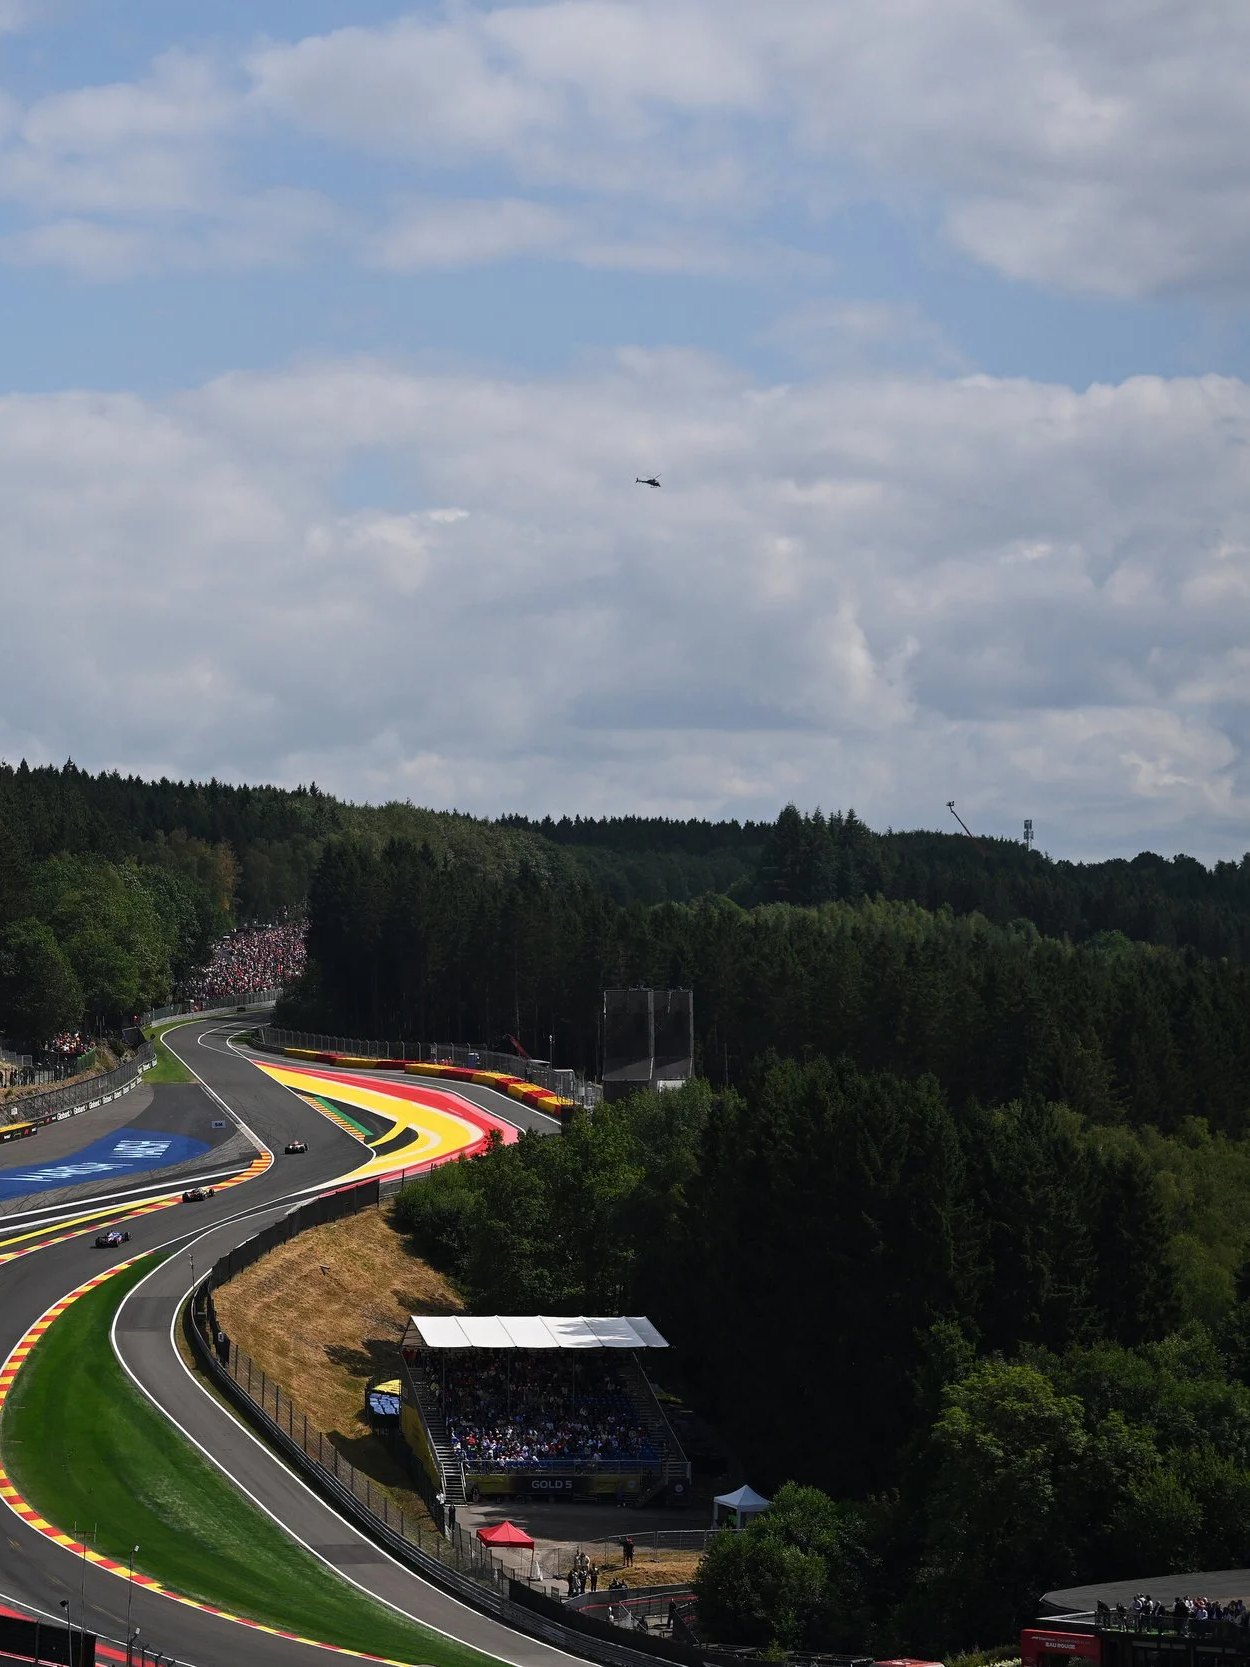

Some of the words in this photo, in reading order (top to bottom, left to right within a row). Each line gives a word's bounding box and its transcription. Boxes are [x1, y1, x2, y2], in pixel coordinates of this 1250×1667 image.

[56, 1110, 71, 1120] Globant
[531, 1480, 563, 1489] GOLD
[564, 1480, 573, 1489] 5
